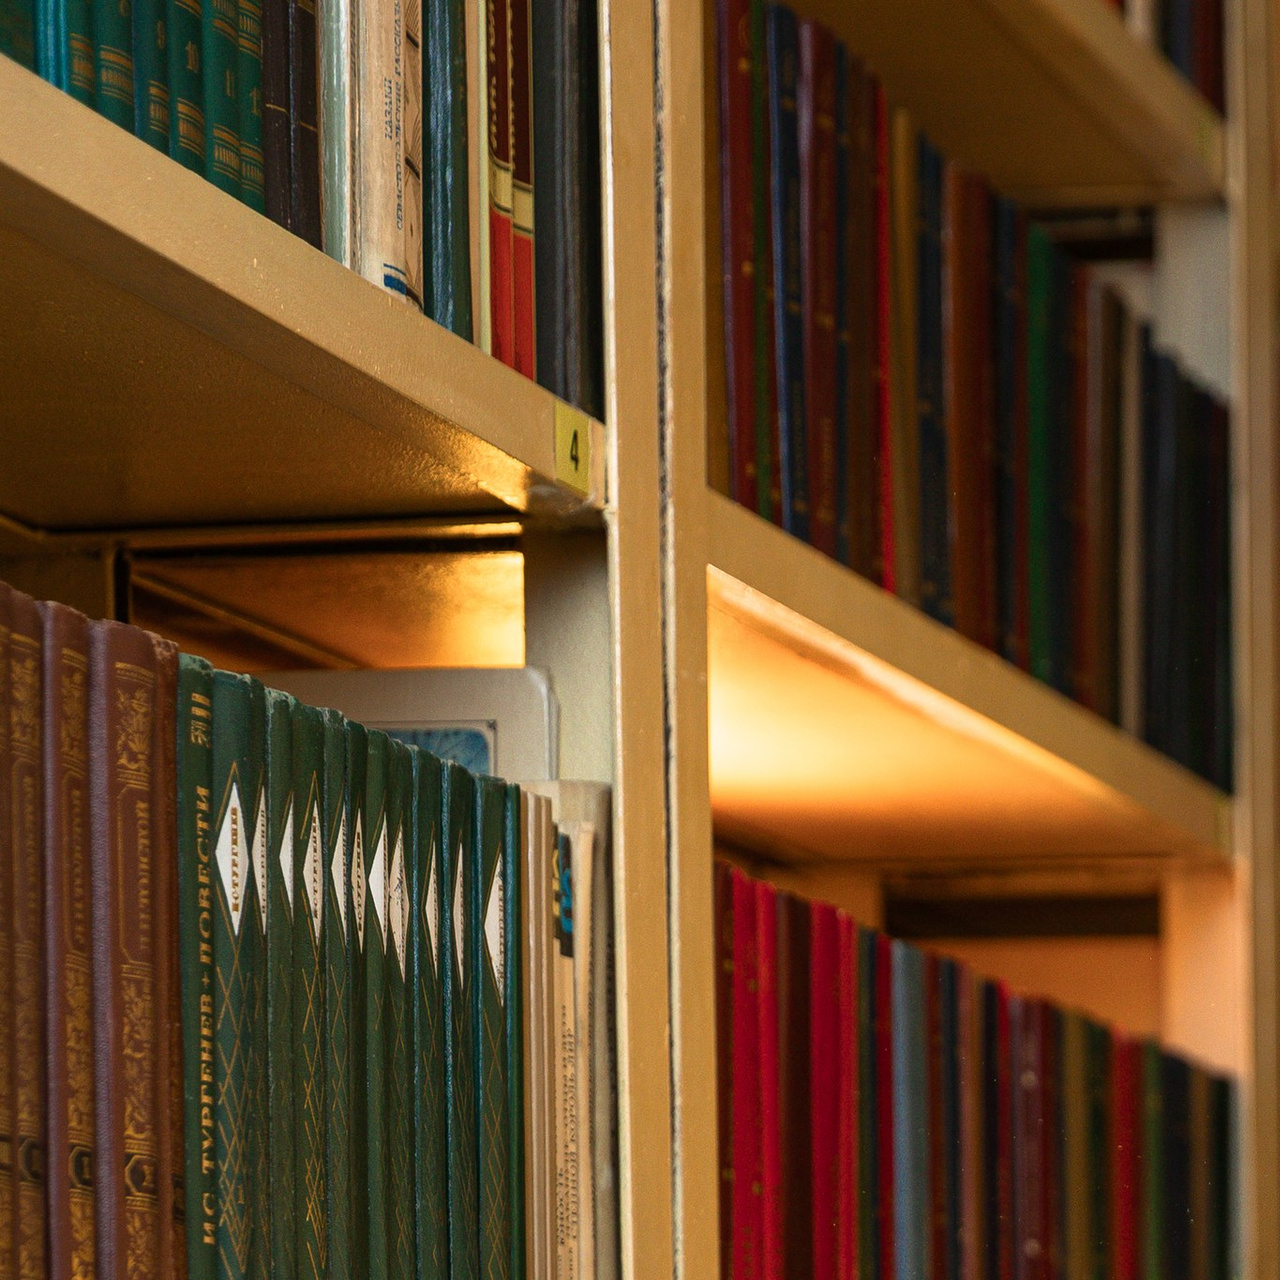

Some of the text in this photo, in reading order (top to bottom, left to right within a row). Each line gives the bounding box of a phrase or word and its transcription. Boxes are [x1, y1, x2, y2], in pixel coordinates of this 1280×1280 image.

[384, 77, 393, 142] КАЗАКИ
[570, 429, 579, 472] 4
[567, 1028, 575, 1068] ЛИР
[568, 1072, 577, 1142] КОРОЛЬ
